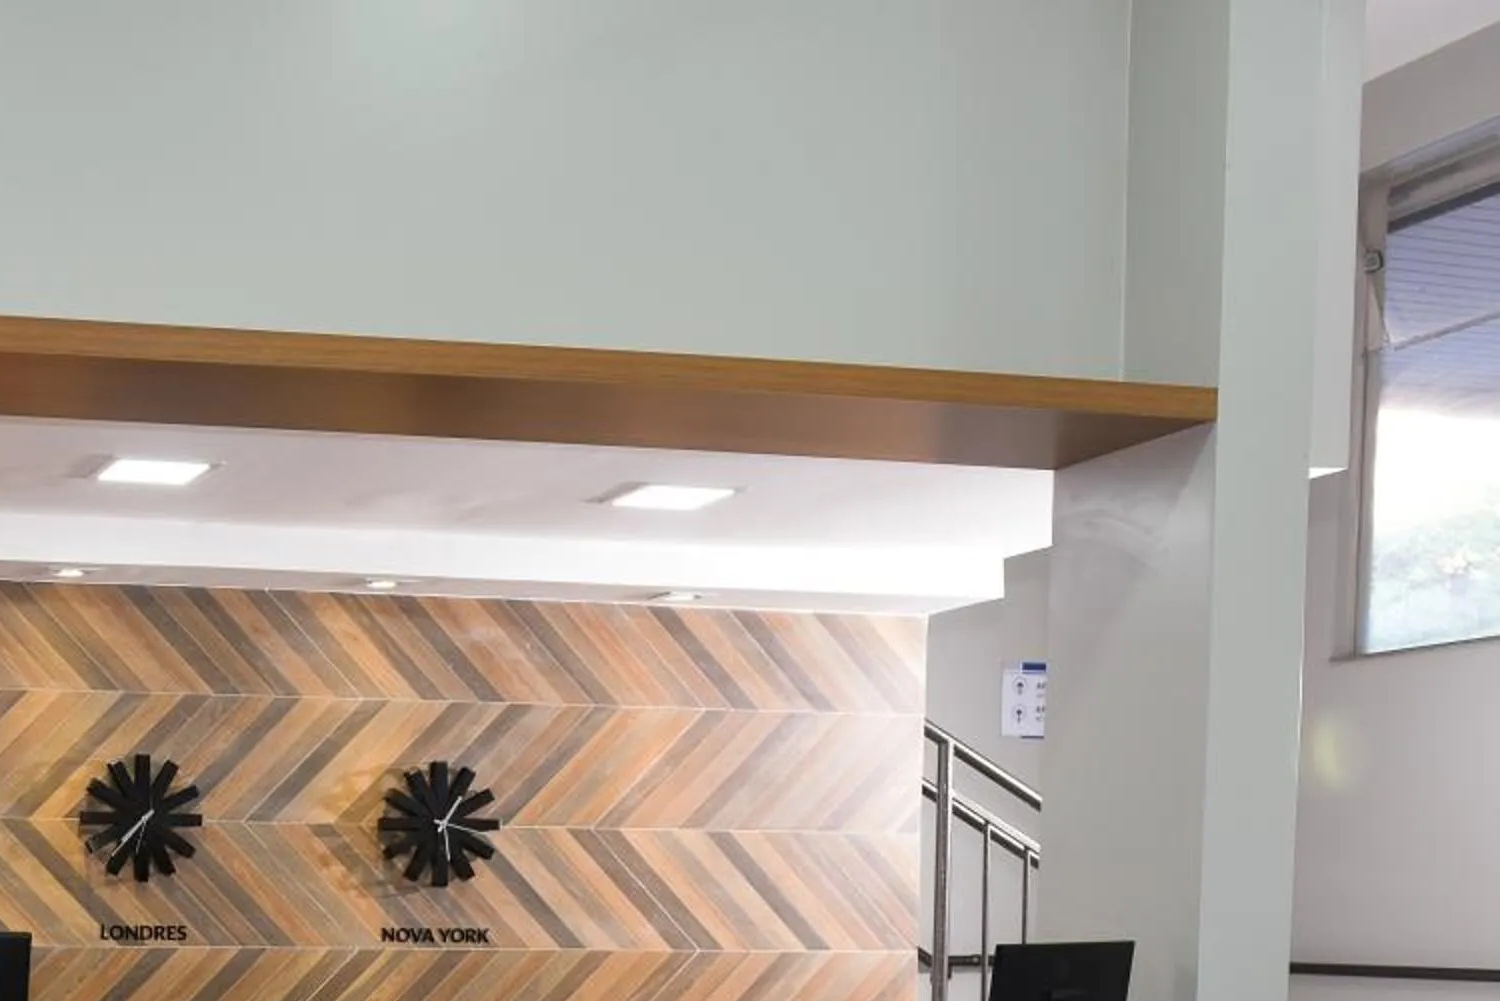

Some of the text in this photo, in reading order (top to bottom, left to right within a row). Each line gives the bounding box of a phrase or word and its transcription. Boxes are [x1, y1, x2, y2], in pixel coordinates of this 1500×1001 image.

[100, 923, 187, 941] LONDRES
[381, 927, 489, 943] NOVA YORK
